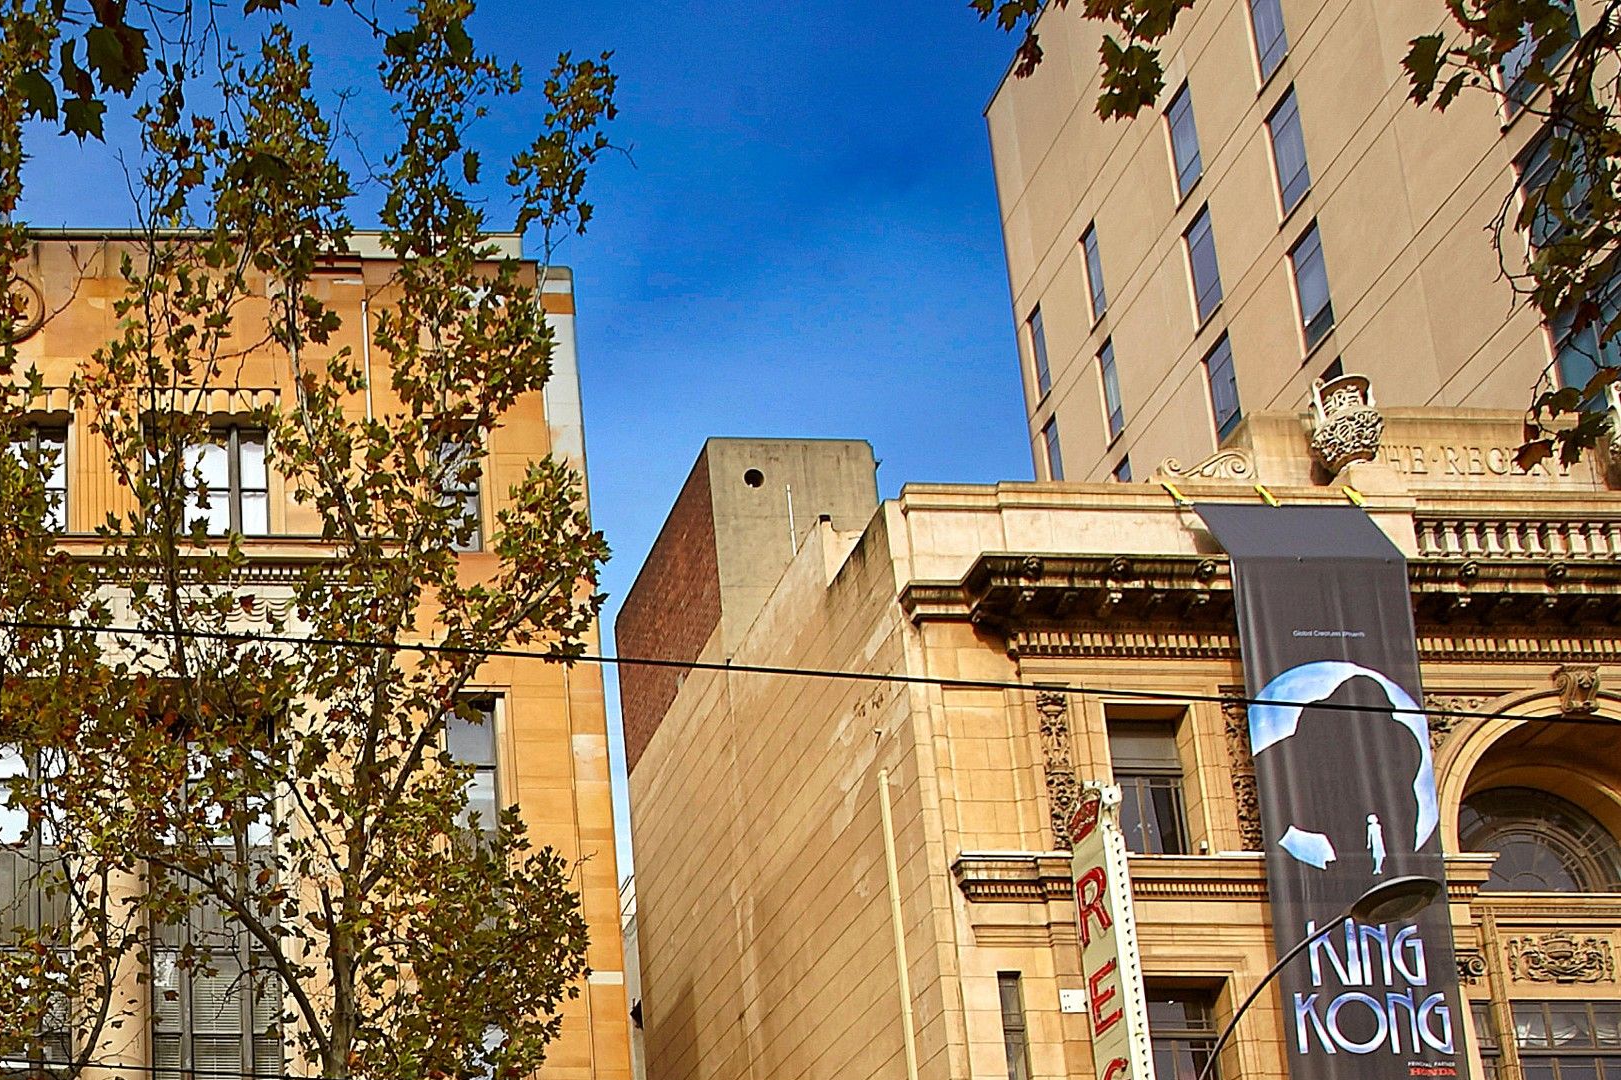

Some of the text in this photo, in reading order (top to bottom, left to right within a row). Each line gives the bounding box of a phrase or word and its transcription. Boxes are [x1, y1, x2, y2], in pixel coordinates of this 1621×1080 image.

[1306, 914, 1428, 987] KING
[1293, 989, 1457, 1055] KONG
[1409, 1067, 1456, 1076] HONDA
